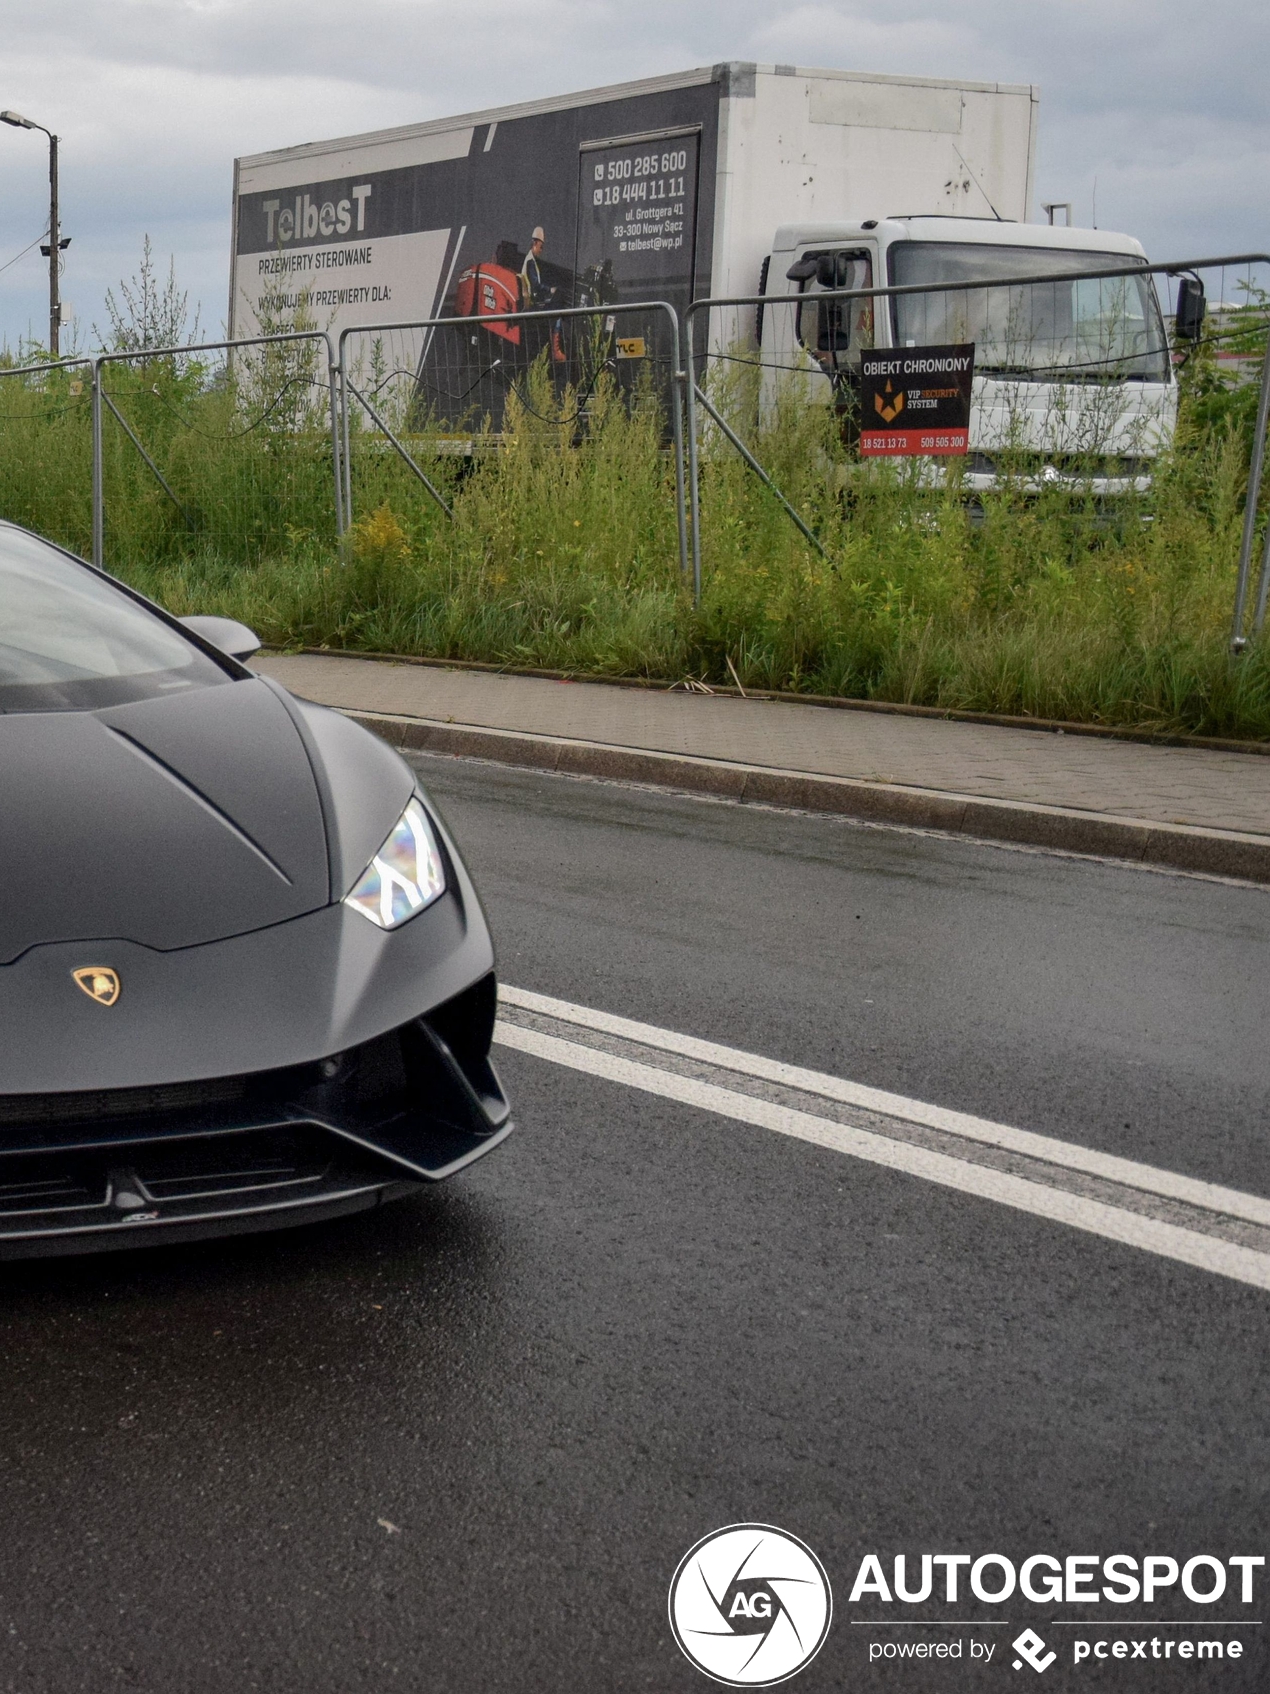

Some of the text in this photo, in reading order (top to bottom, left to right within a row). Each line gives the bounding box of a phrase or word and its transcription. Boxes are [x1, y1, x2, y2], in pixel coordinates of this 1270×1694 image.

[607, 151, 686, 180] 500 285 600
[604, 177, 685, 205] 18 444 11 11
[262, 184, 372, 243] TelbesT
[625, 203, 683, 221] ul. Grottgera 41
[613, 220, 683, 238] 33-300 Nowy Sącz
[628, 235, 682, 251] telbest@wp.pl
[258, 247, 372, 276] PRZEWIERTY STEROWANE
[316, 287, 370, 307] PRZEWIERTY
[371, 285, 392, 302] DLA:
[863, 357, 971, 376] OBIEKT CHRONIONY
[907, 388, 959, 399] VIP SECURITY
[907, 398, 938, 409] SYSTEM
[863, 436, 964, 449] 18 521 13 73 509 505 300
